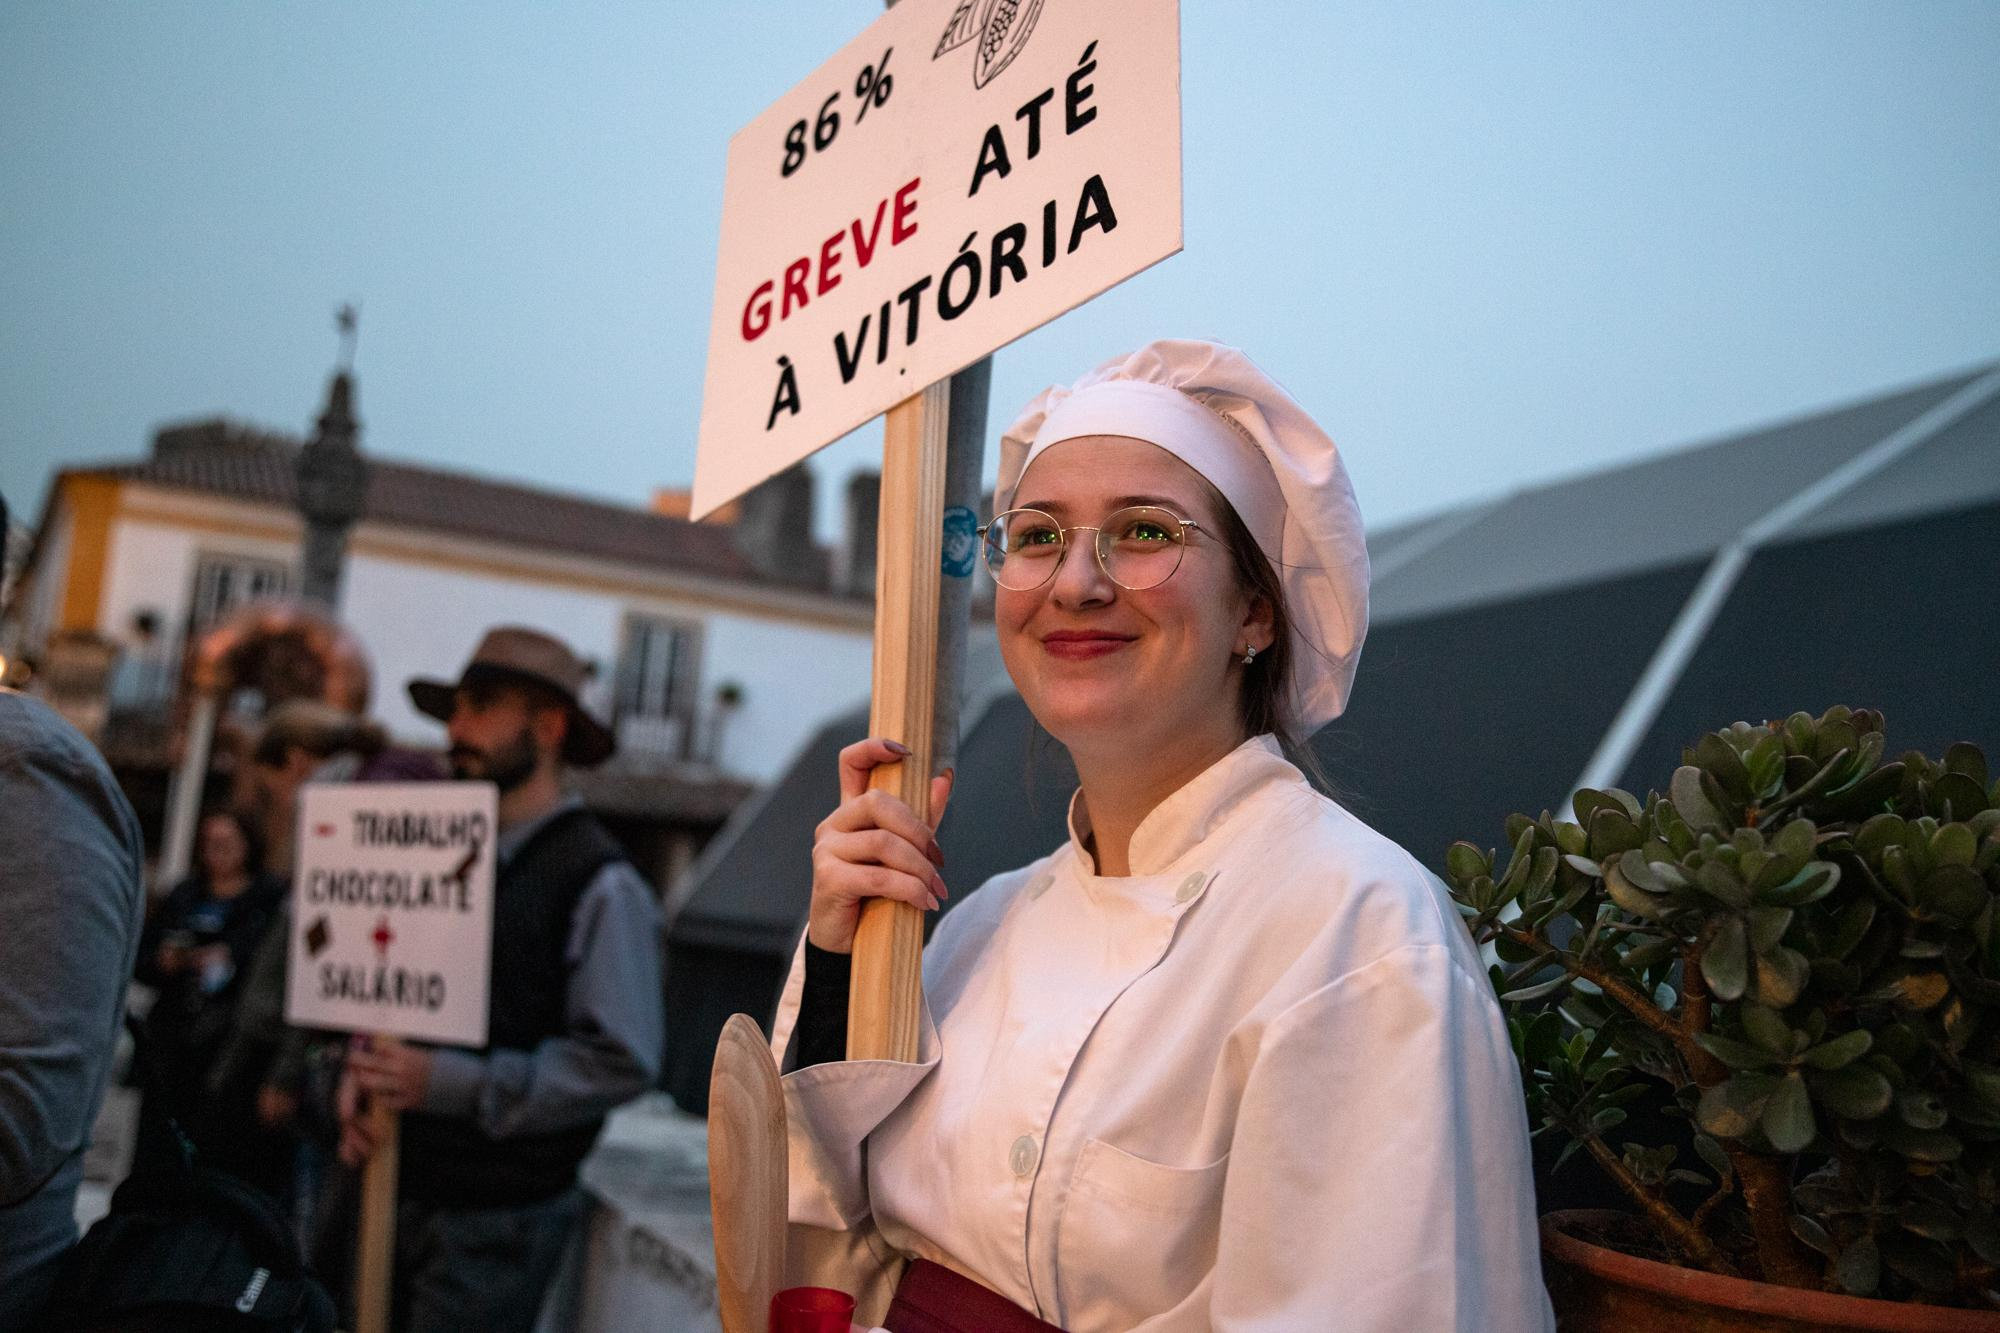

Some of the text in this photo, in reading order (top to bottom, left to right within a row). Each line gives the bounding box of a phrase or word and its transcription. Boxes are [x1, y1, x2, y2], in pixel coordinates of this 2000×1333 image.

[741, 39, 1099, 342] GREVE ATÉ
[765, 173, 1118, 432] À VITÓRIA
[306, 869, 471, 912] CHOCOLATE
[353, 810, 488, 848] TRABALHO
